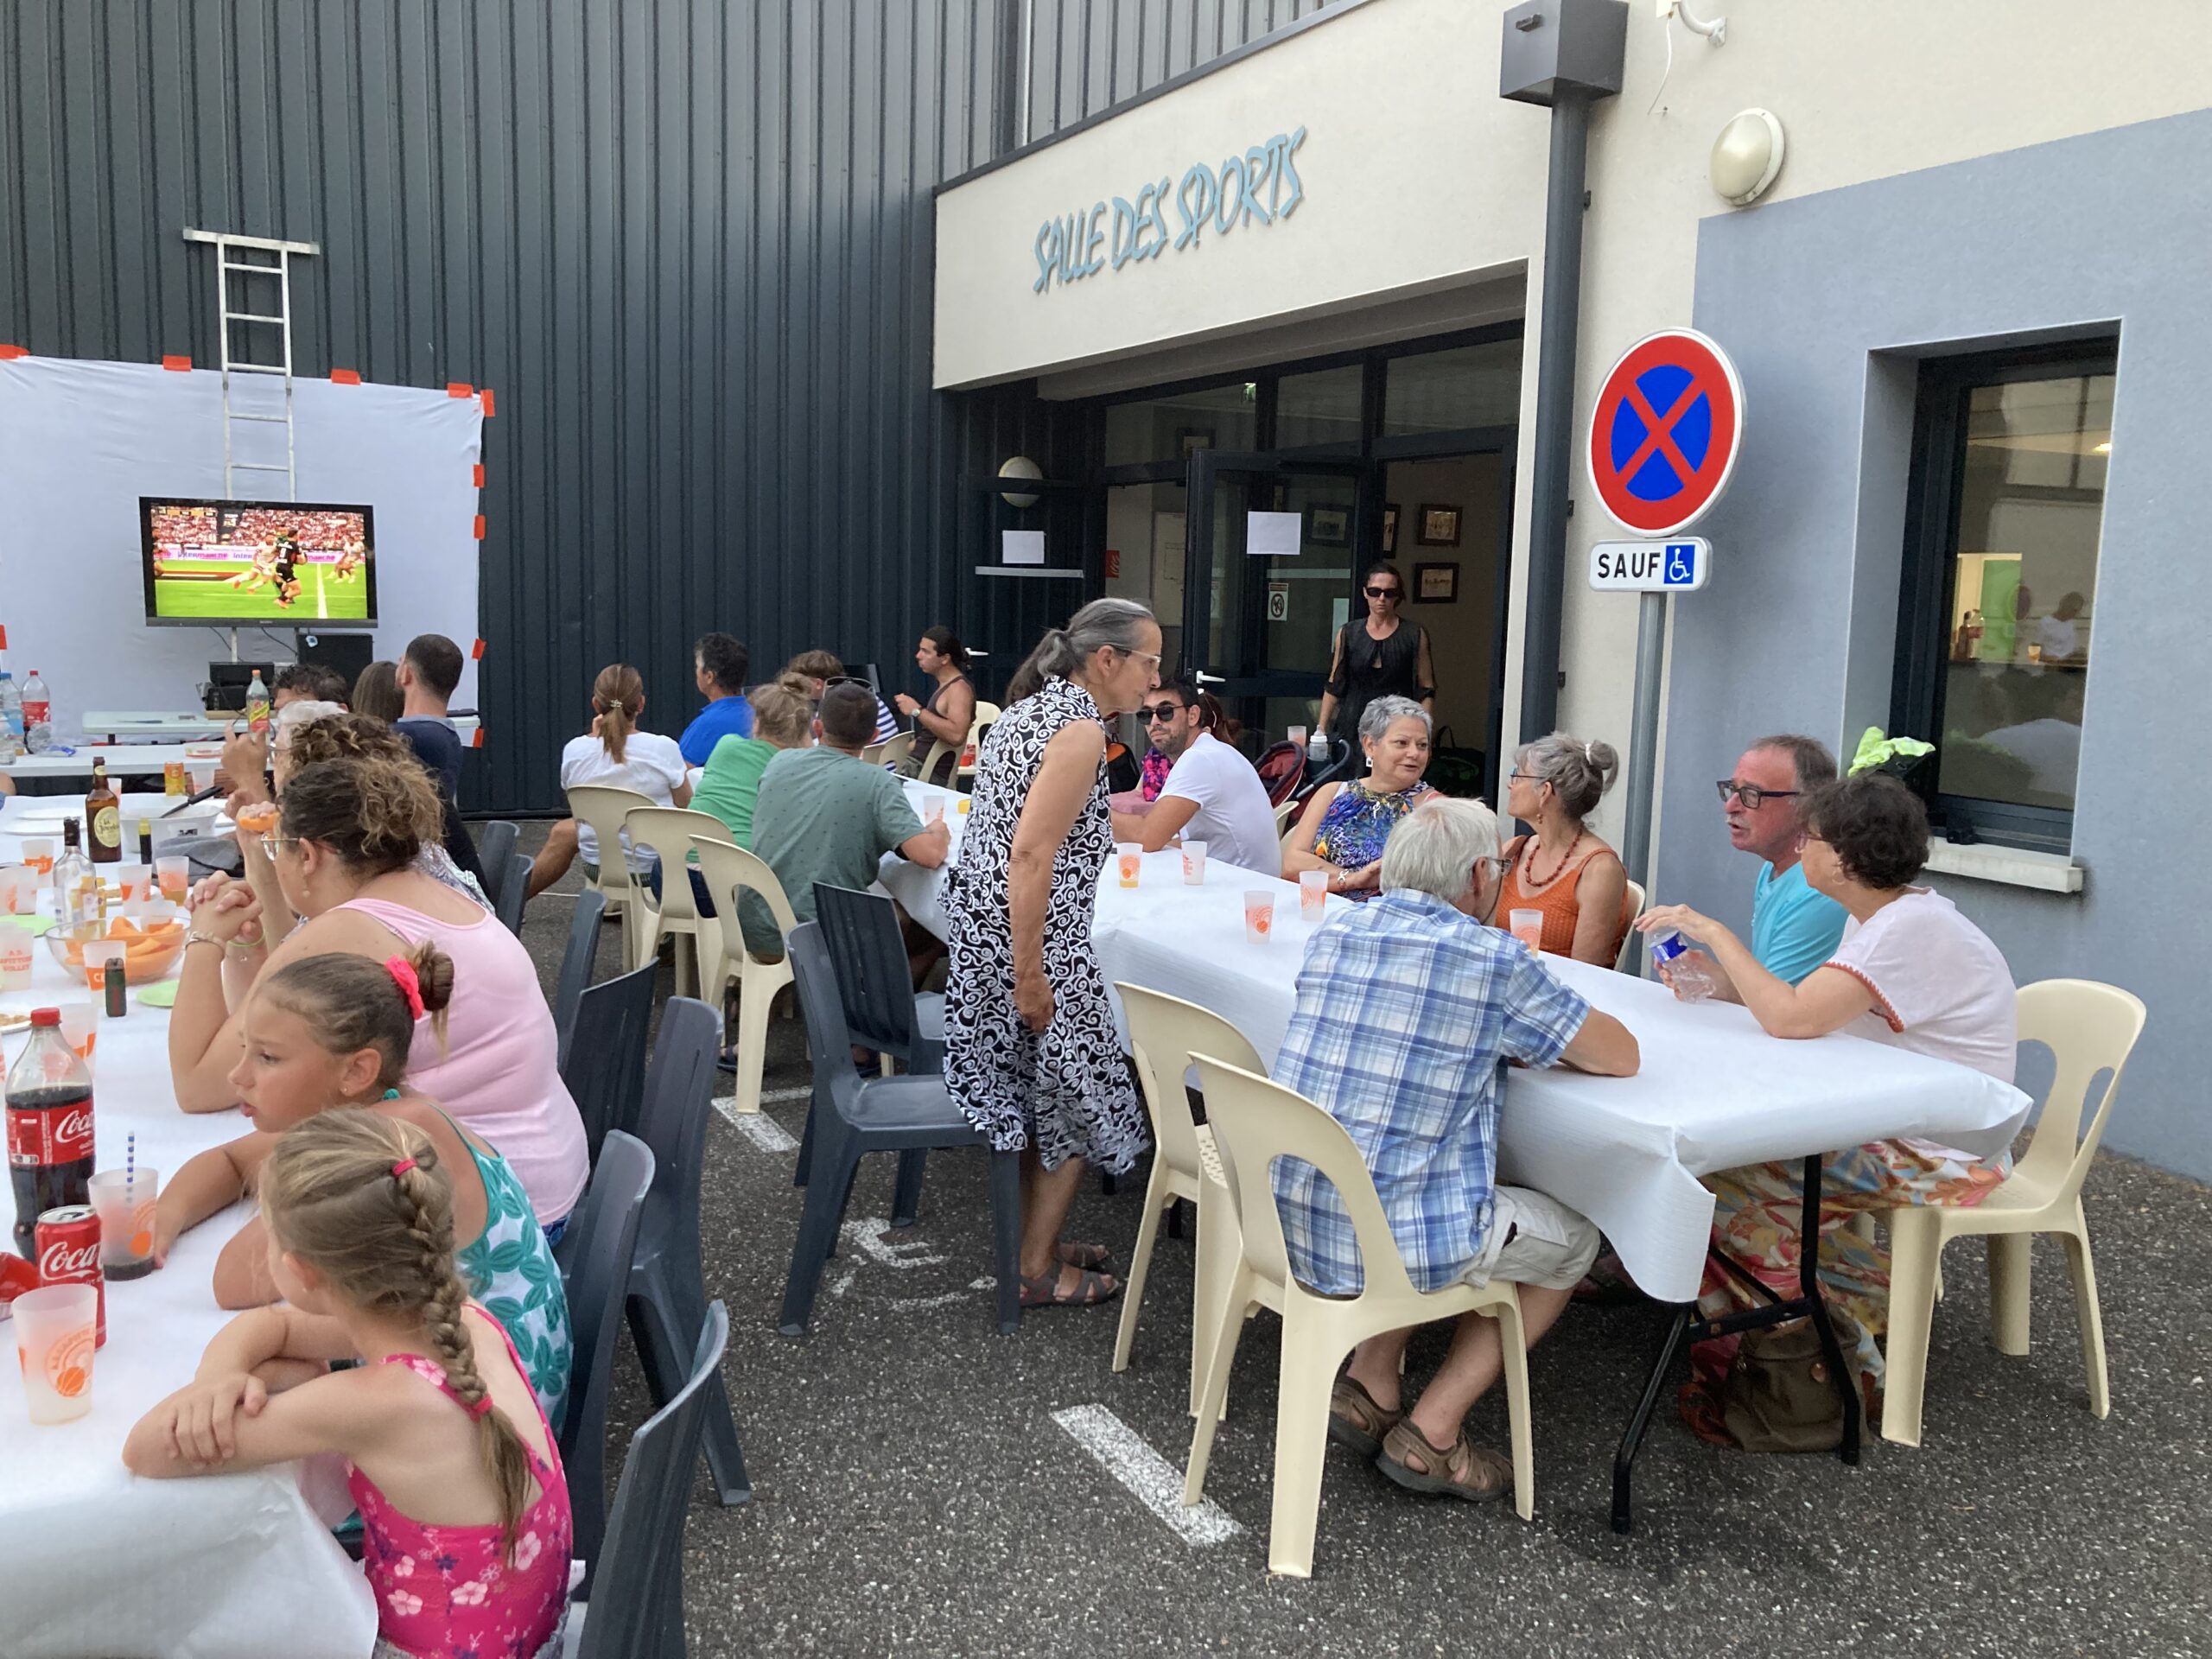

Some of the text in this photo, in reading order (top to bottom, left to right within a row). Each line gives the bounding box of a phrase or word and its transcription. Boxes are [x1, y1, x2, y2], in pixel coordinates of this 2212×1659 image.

[1033, 124, 1307, 295] SALLE DES SPORTS
[1598, 552, 1661, 579] SAUF
